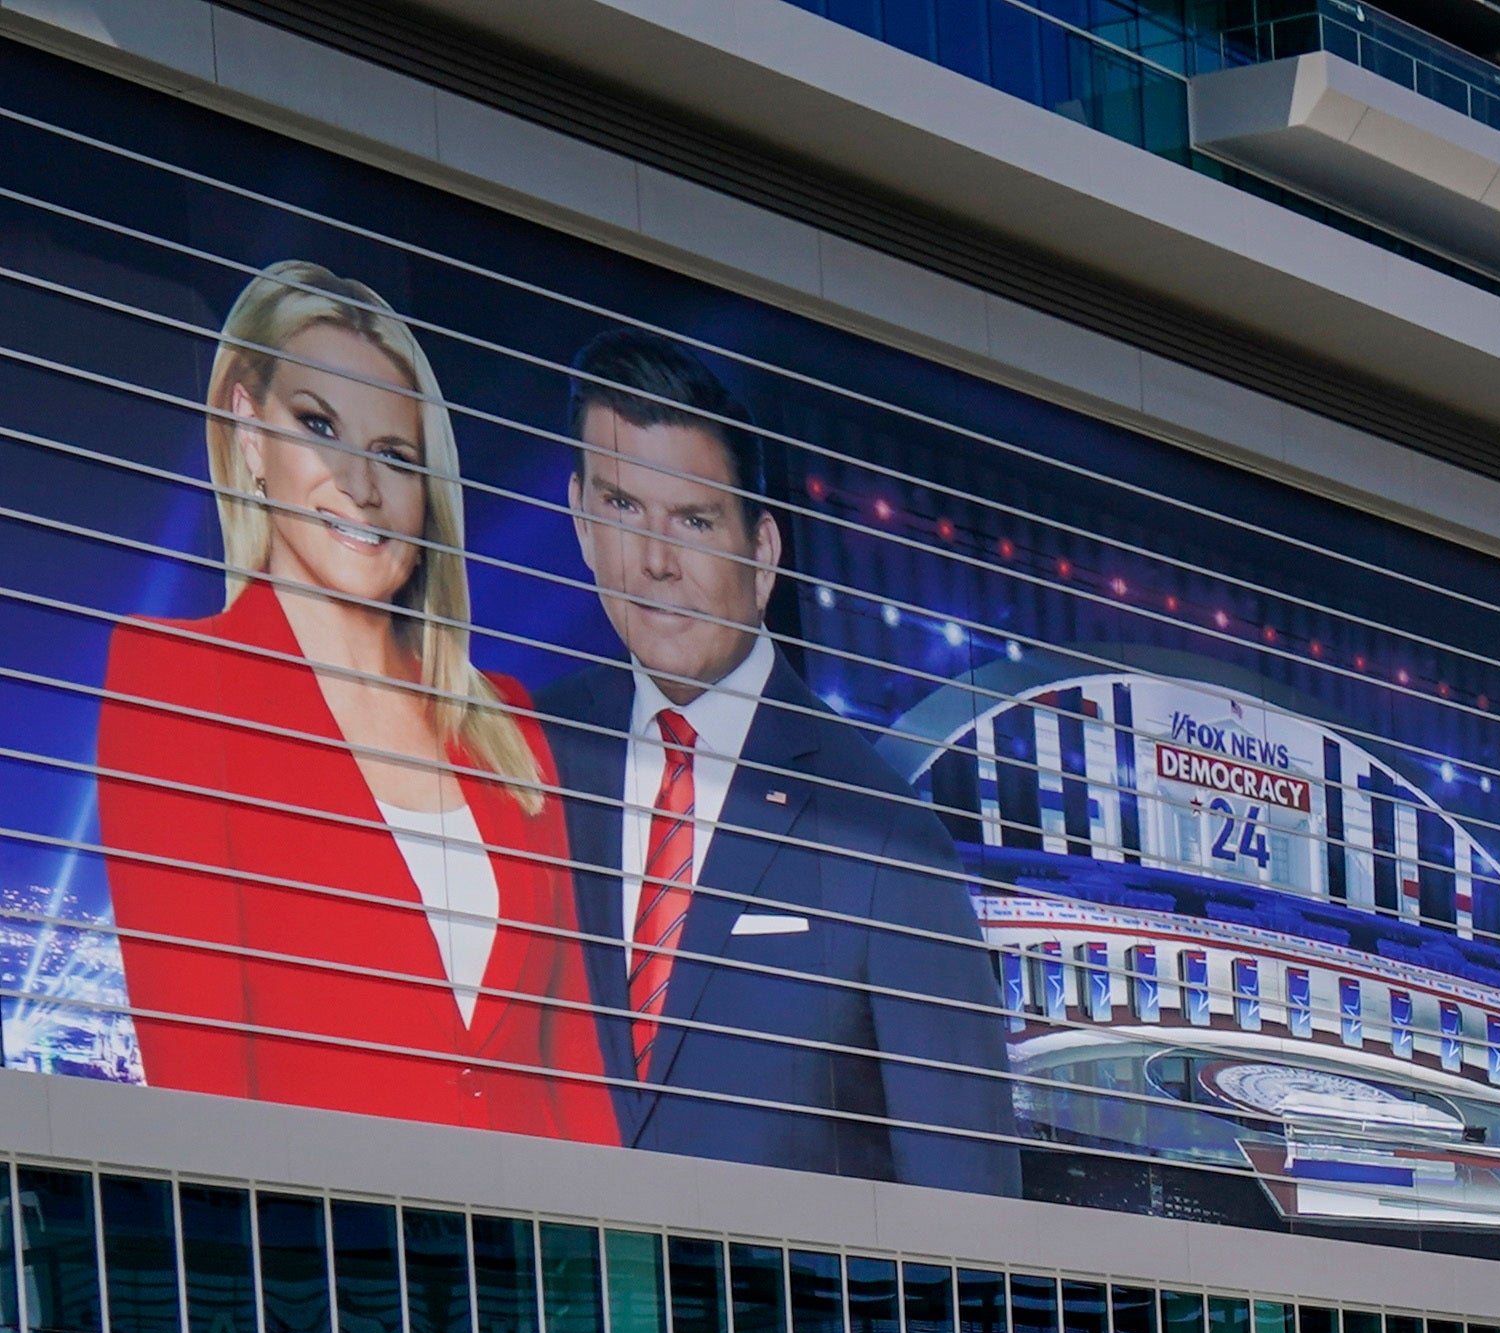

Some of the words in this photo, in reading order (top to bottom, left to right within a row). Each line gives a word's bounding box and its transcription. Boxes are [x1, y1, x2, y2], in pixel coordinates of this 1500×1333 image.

[1186, 720, 1227, 753] FOX
[1231, 733, 1289, 769] NEWS
[1161, 749, 1304, 808] DEMOCRACY
[1209, 797, 1270, 868] 24
